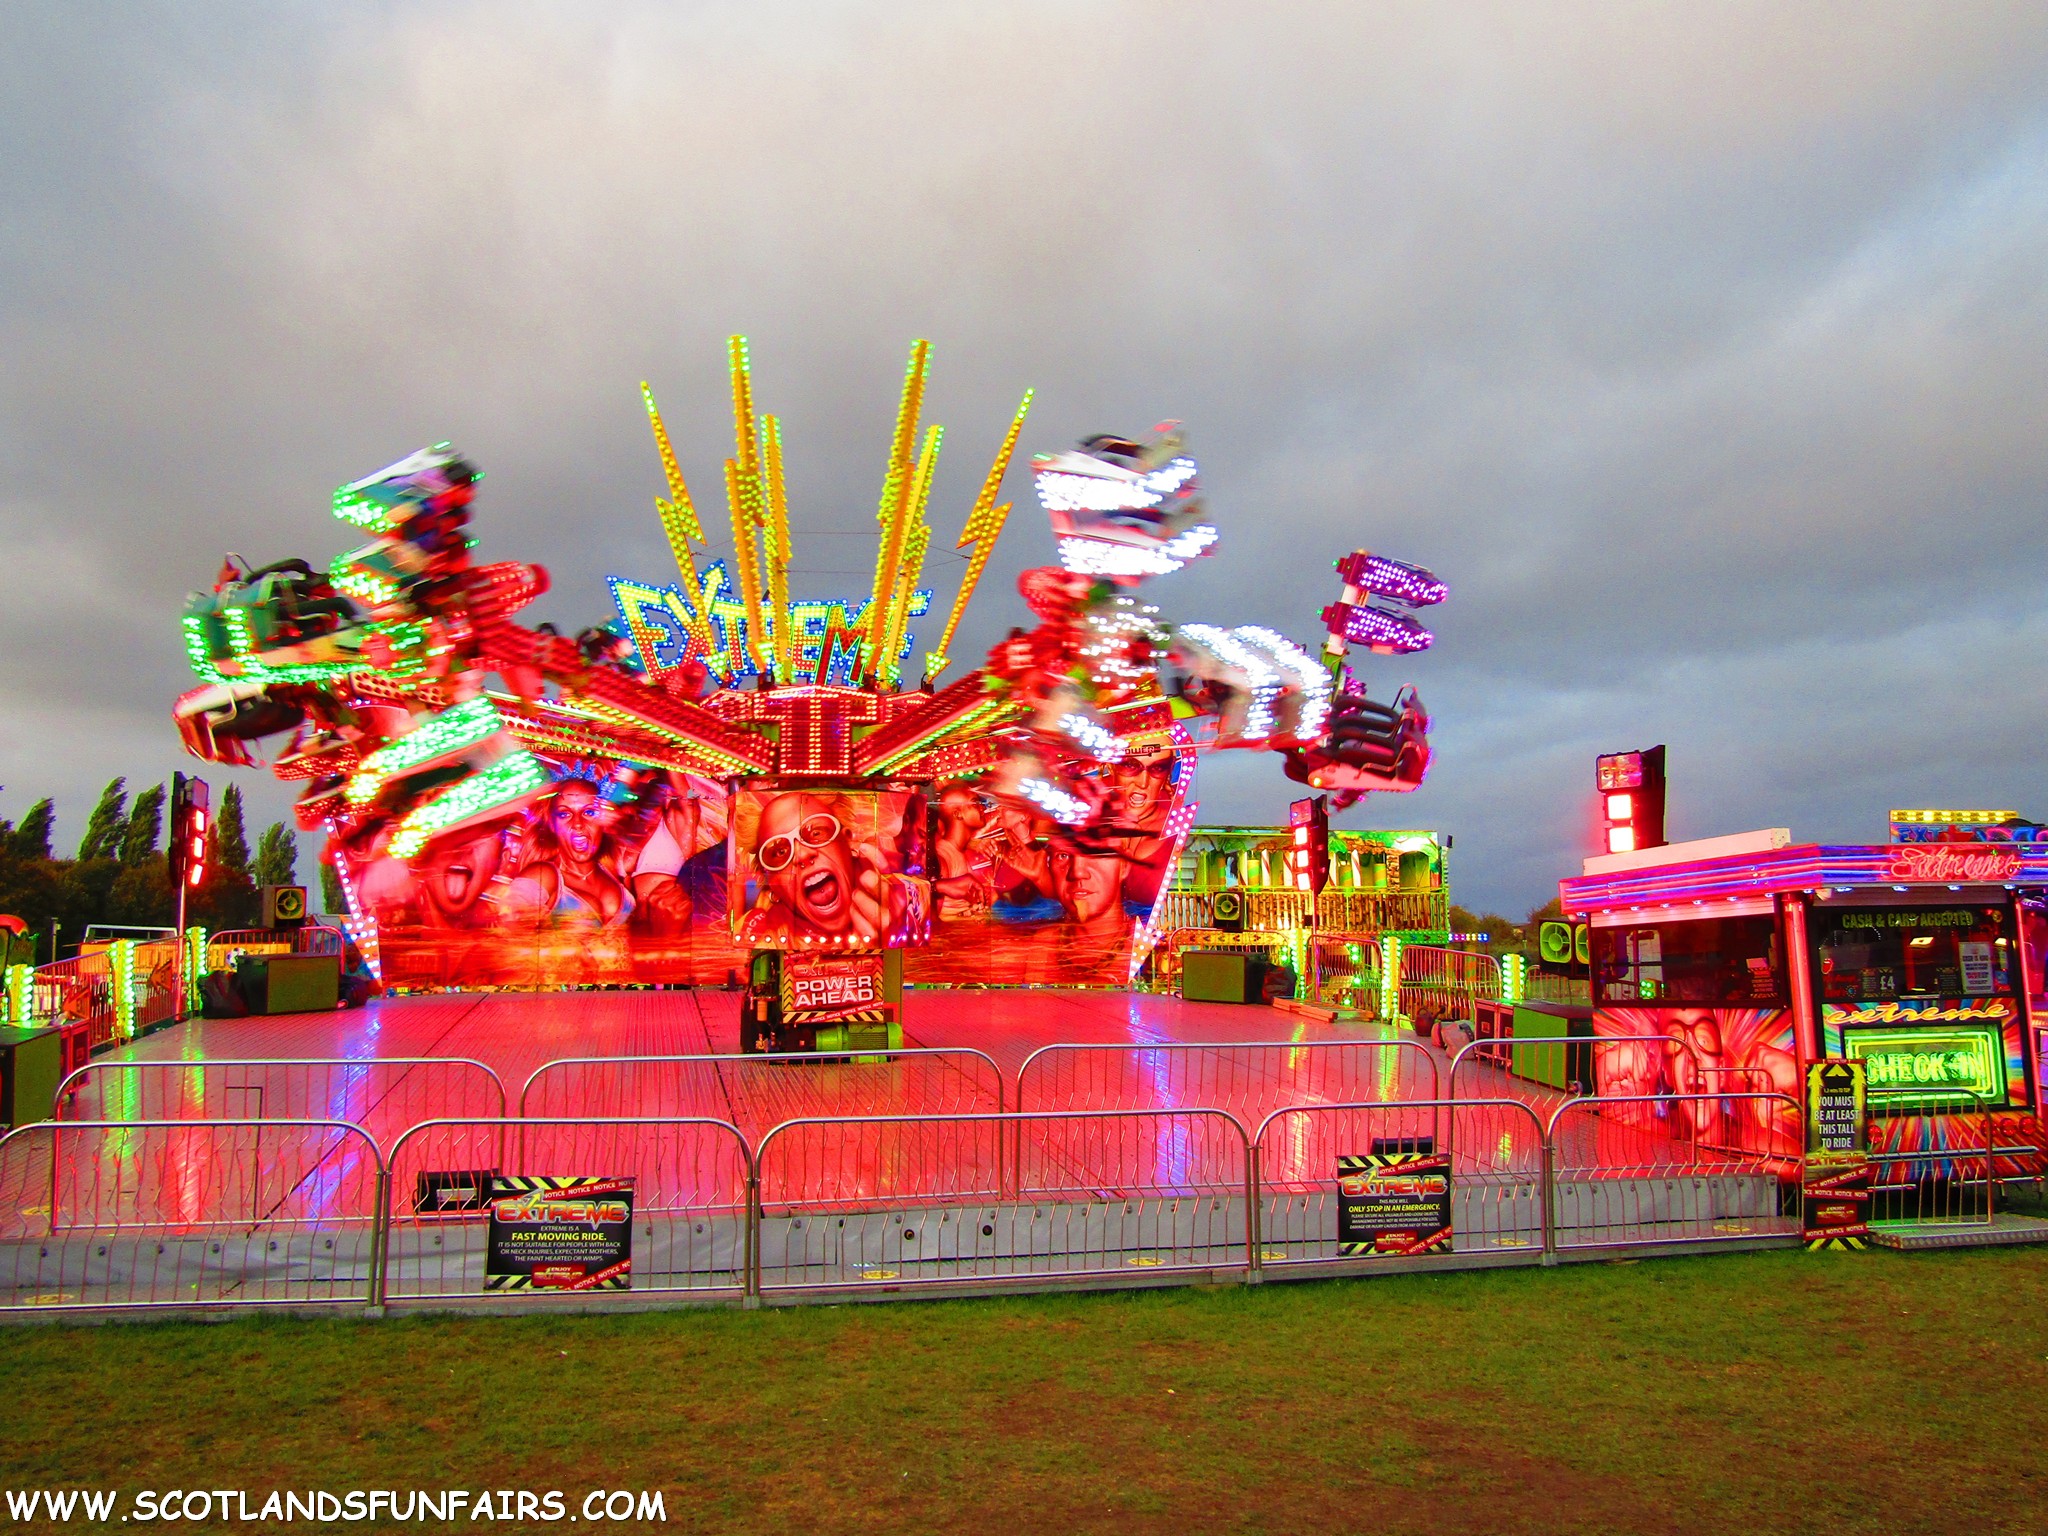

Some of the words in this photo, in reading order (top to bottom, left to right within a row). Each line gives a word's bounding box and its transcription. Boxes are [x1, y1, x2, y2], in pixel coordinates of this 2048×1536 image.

[1842, 913, 1873, 929] CASH
[1876, 914, 1885, 928] &
[1887, 912, 1918, 928] CARD
[1920, 910, 1974, 927] ACCEPTED
[795, 976, 872, 992] POWER
[1880, 975, 1895, 990] £4
[795, 989, 874, 1007] AHEAD
[1827, 1003, 2009, 1025] extreme
[1817, 1096, 1833, 1106] YOU
[1835, 1096, 1856, 1106] MUST
[1815, 1110, 1824, 1120] BE
[1826, 1110, 1835, 1120] AT
[1837, 1110, 1859, 1120] LEAST
[1818, 1124, 1836, 1134] THIS
[1837, 1124, 1855, 1134] TALL
[1821, 1138, 1832, 1148] TO
[1833, 1137, 1852, 1148] RIDE
[568, 1187, 590, 1195] NOTICE
[594, 1183, 616, 1191] NOTICE
[1343, 1171, 1447, 1198] EXTREME
[497, 1192, 628, 1226] EXTREME
[1348, 1205, 1365, 1213] ONLY
[512, 1232, 536, 1241] FAST
[538, 1232, 579, 1241] MOVING
[581, 1232, 607, 1241] RIDE.
[573, 1277, 596, 1290] NOTICE
[598, 1267, 620, 1280] NOTICE
